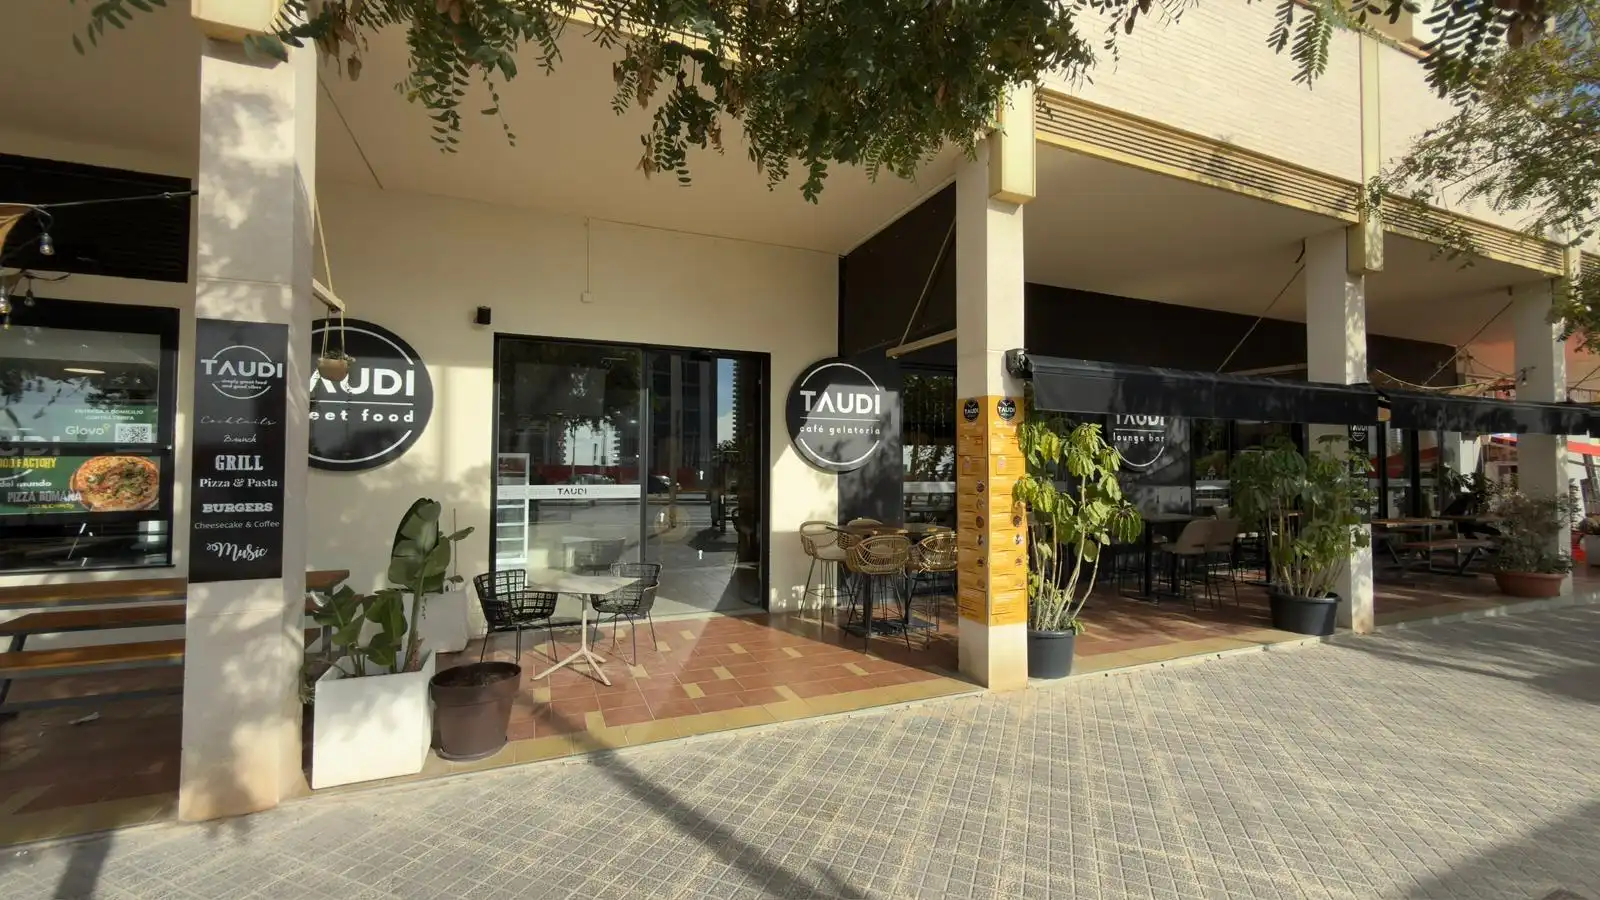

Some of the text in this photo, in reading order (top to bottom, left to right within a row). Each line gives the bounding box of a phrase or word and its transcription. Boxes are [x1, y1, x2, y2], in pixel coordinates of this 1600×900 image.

[200, 359, 283, 378] TAUDI
[310, 367, 415, 396] AUDI
[800, 390, 880, 415] TAUDI
[200, 416, 277, 425] Cocktails
[309, 408, 414, 422] eet food
[65, 425, 104, 435] Glovo
[800, 424, 881, 436] café gelateria
[224, 434, 256, 443] Brunch
[1113, 431, 1165, 444] lounge bar
[16, 456, 57, 468] FACTORY
[215, 454, 264, 471] GRILL
[200, 478, 278, 488] Pizza & Pasta
[7, 491, 36, 502] PIZZA
[557, 487, 587, 495] TAUDI
[202, 502, 273, 513] BURGERS
[194, 521, 243, 530] Cheesecake
[254, 520, 280, 528] Coffee
[206, 542, 268, 562] Music
